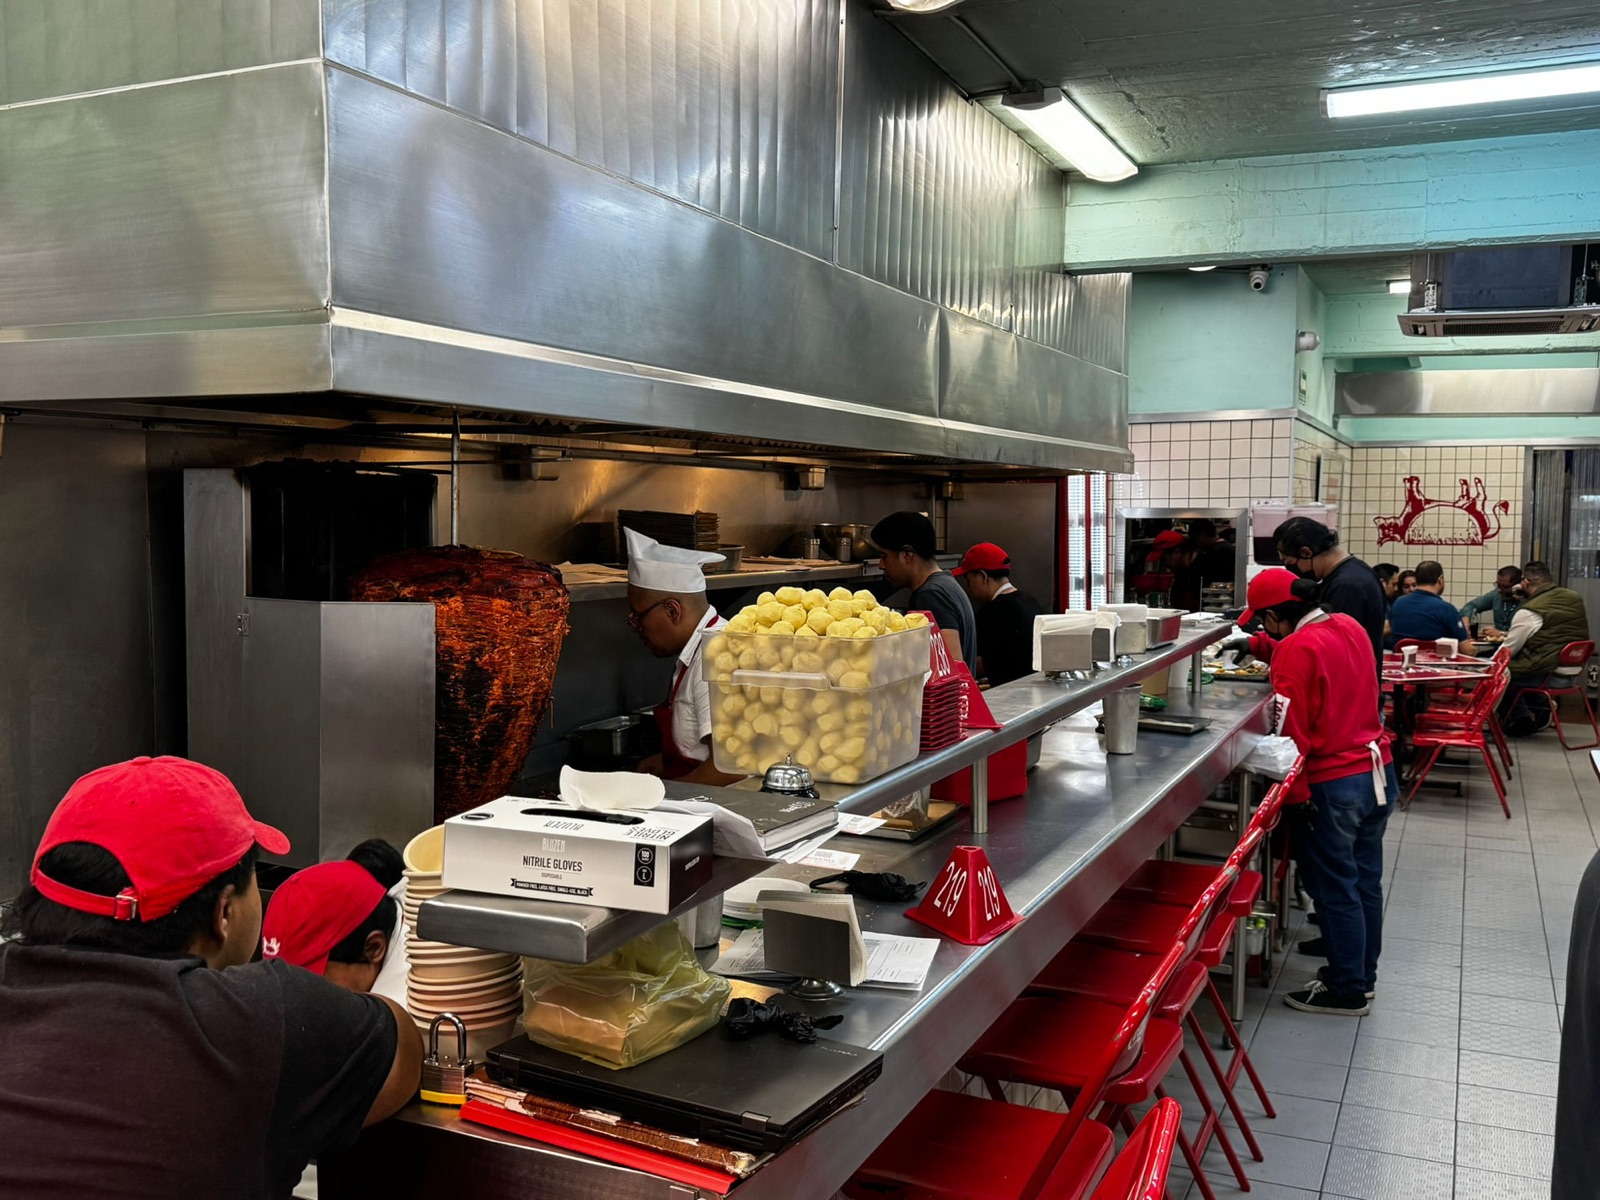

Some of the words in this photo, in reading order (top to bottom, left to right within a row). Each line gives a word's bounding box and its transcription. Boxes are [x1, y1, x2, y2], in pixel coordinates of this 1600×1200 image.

[522, 855, 551, 869] NITRILE
[553, 858, 583, 872] GLOVES
[541, 872, 563, 880] DISPOSABLE
[933, 861, 967, 918] 219
[977, 865, 1001, 921] 219
